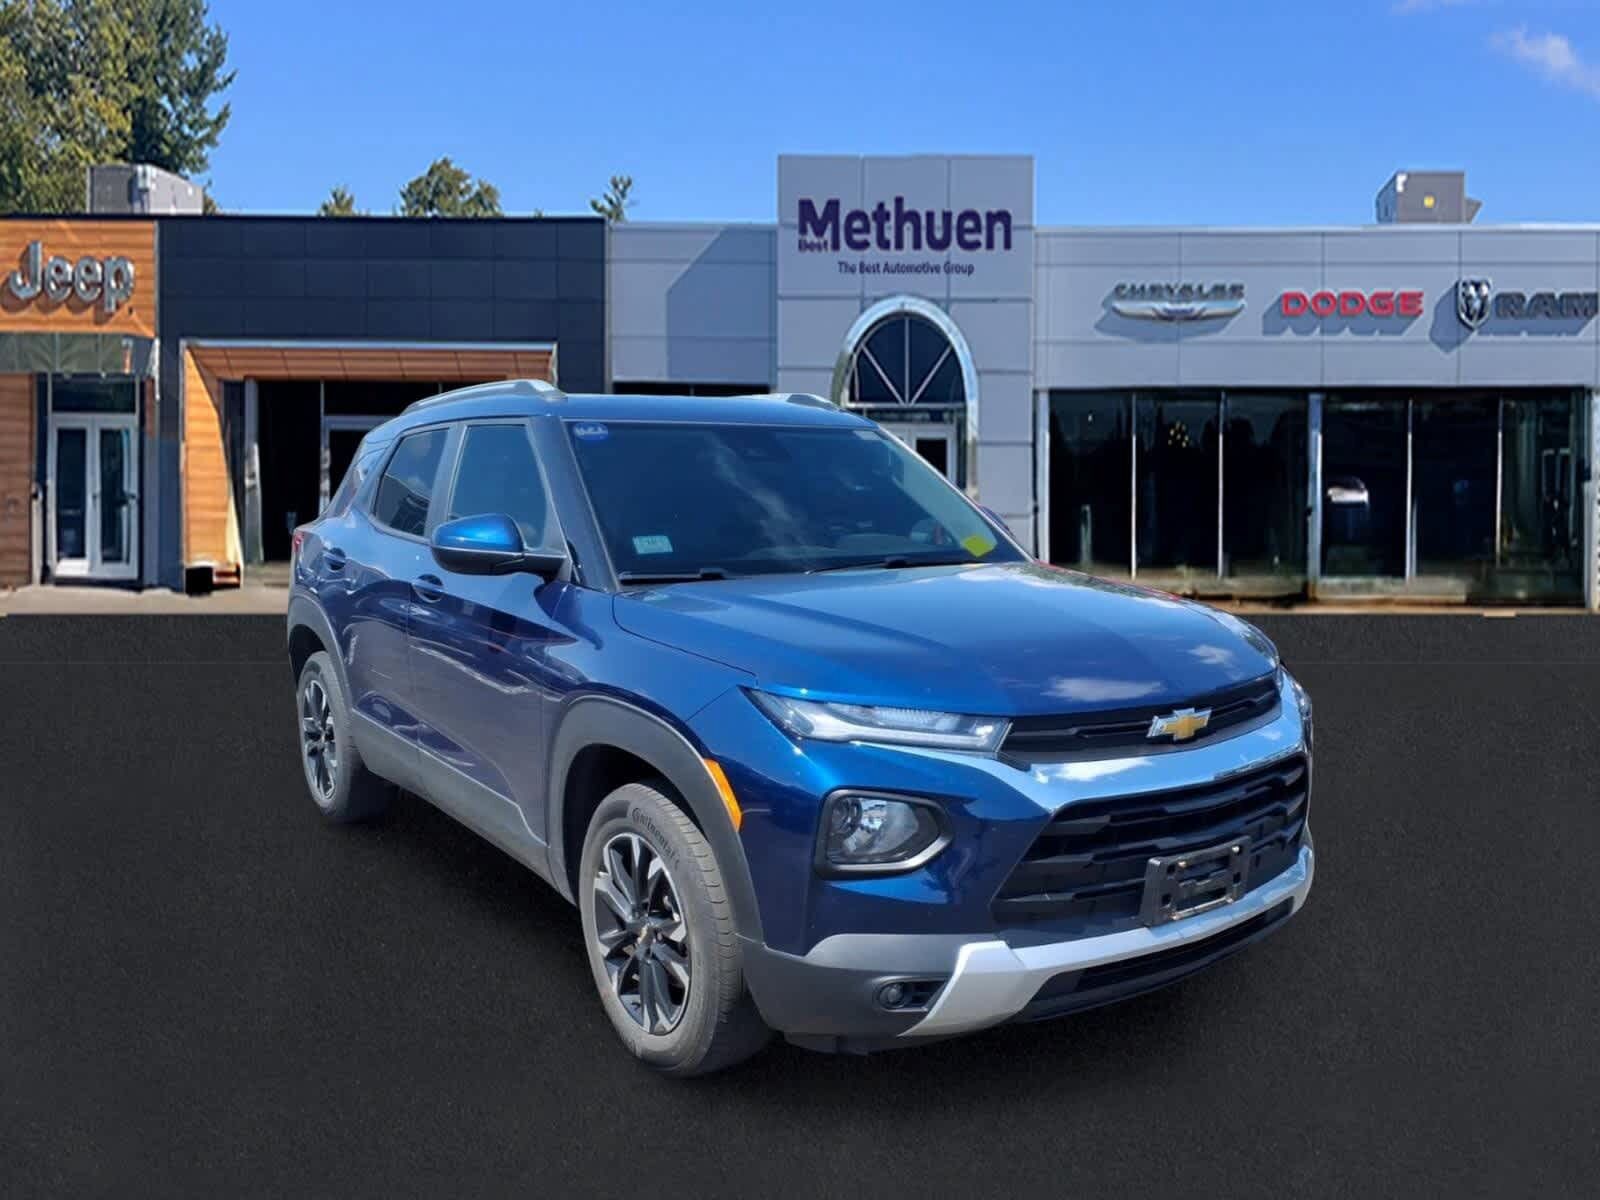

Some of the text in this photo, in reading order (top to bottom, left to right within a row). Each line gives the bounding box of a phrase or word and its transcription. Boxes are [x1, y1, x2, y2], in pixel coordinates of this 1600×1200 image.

[798, 196, 1012, 251] Methuen
[9, 240, 135, 312] Jeep
[838, 261, 974, 276] The Best Automotive Group
[1114, 283, 1244, 299] CHRYSLER
[1281, 291, 1423, 316] DODGE
[1495, 291, 1599, 319] RAM
